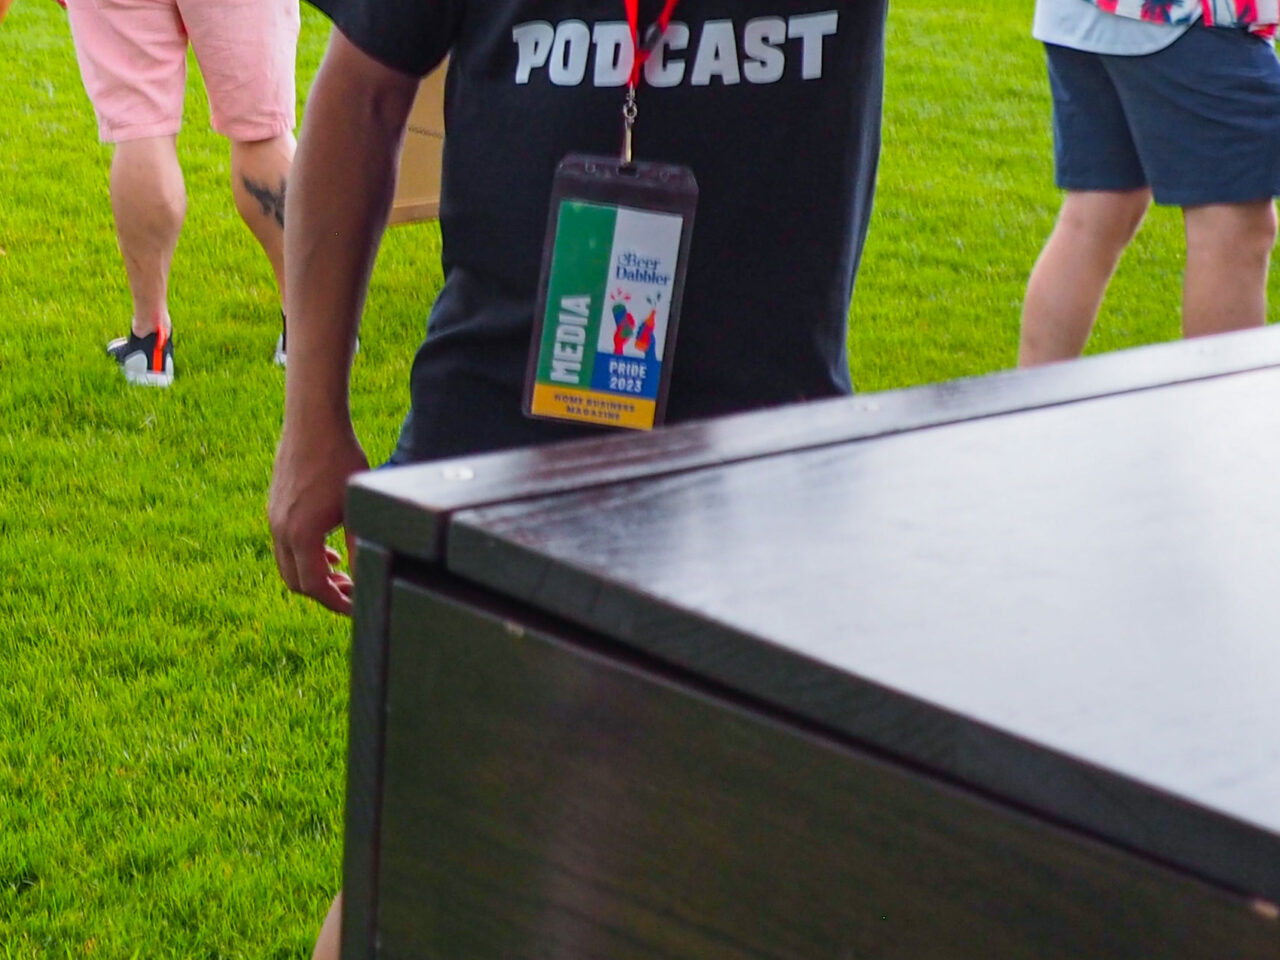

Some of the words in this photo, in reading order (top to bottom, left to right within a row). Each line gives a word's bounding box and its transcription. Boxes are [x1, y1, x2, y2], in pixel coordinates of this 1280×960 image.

[512, 9, 838, 88] PODCAST
[617, 252, 660, 270] Beer
[616, 265, 671, 285] Dabbler
[550, 293, 591, 384] MEDIA
[609, 359, 647, 378] PRIDE
[609, 377, 642, 393] 2023
